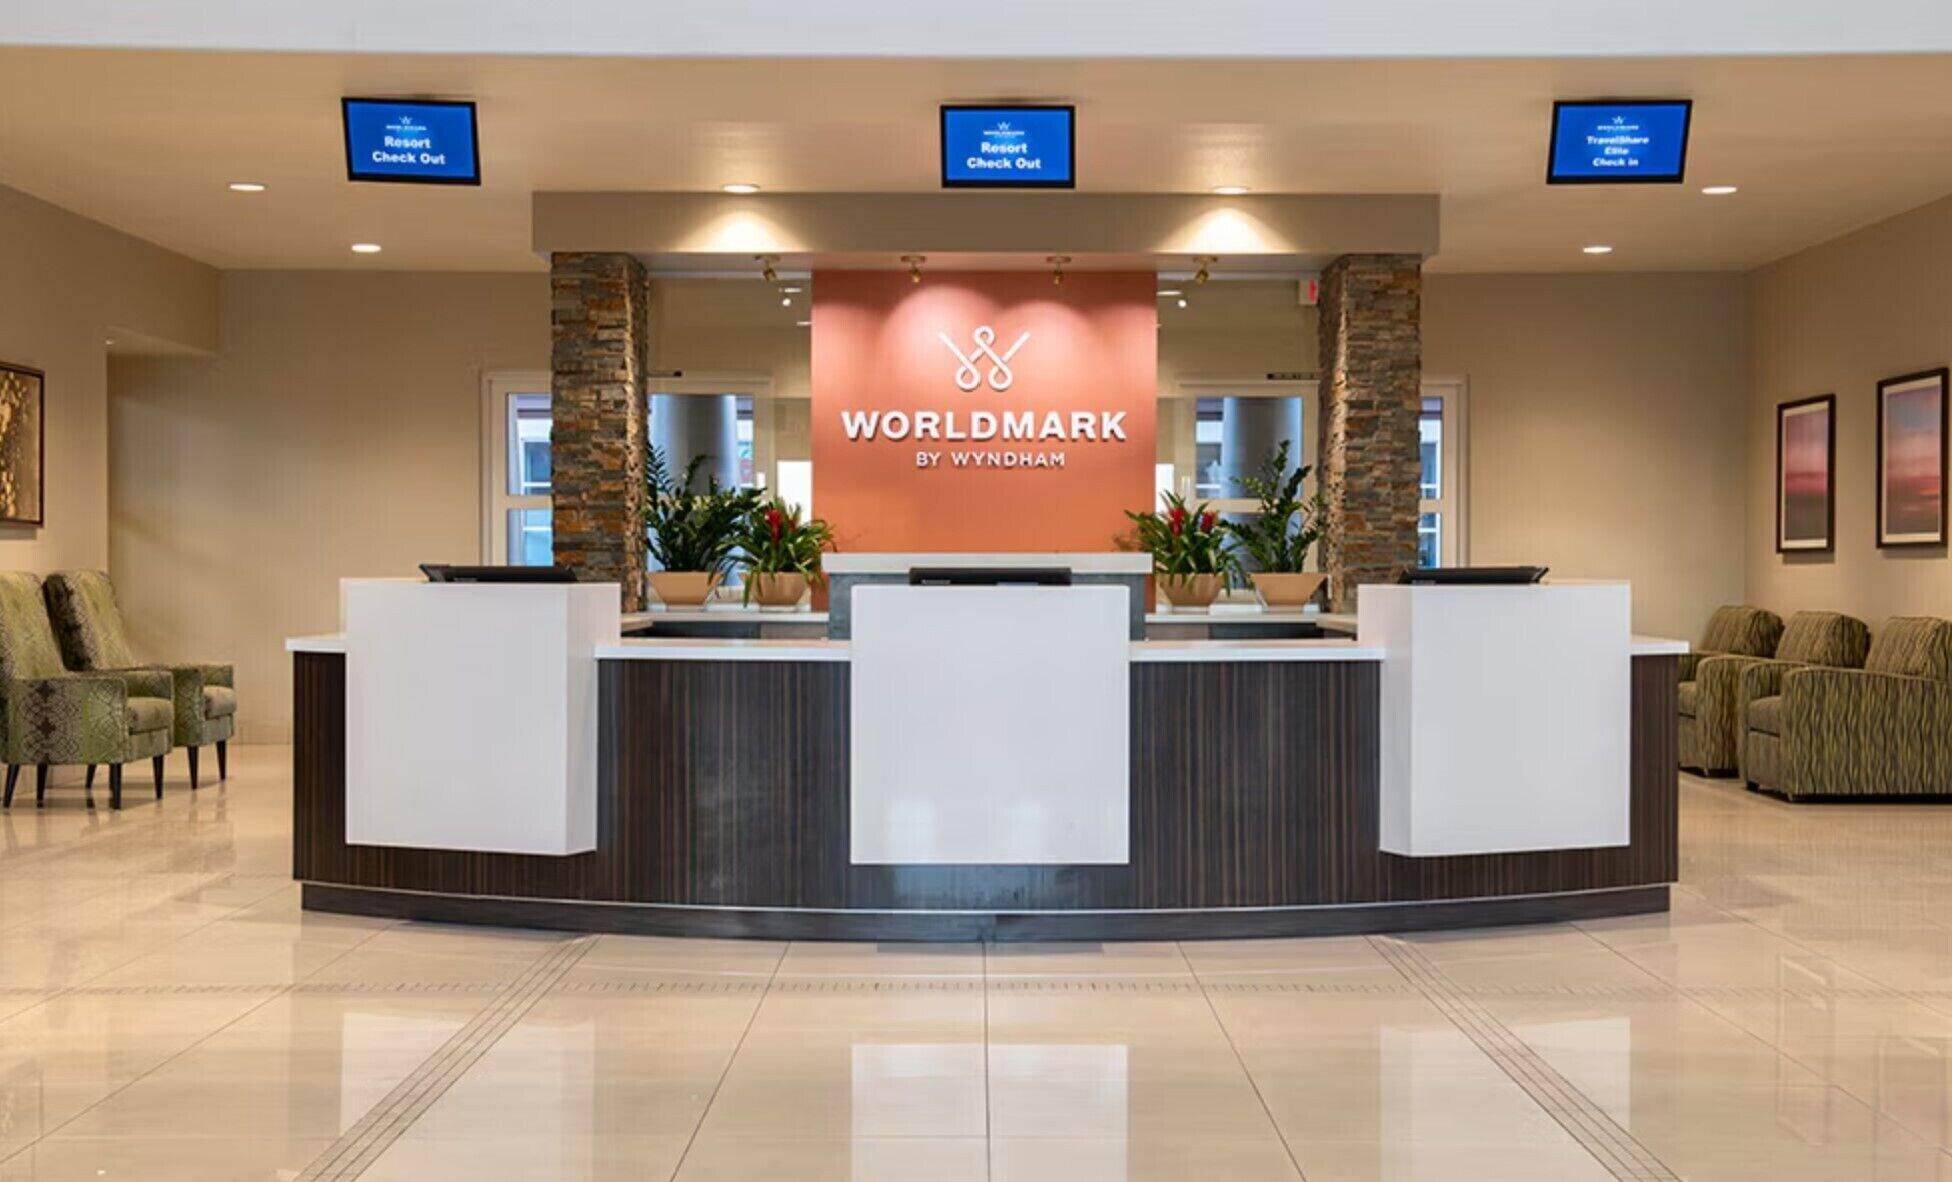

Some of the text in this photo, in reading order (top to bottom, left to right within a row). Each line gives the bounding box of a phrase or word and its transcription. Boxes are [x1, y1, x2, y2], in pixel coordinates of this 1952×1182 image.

[384, 136, 431, 148] Resort
[981, 142, 1027, 153] Resort
[372, 151, 446, 164] Check Out
[966, 158, 1041, 169] Check Out
[1592, 158, 1625, 166] Check
[841, 410, 1128, 441] WORLDMARK
[916, 452, 1066, 467] BY WYNDHAM
